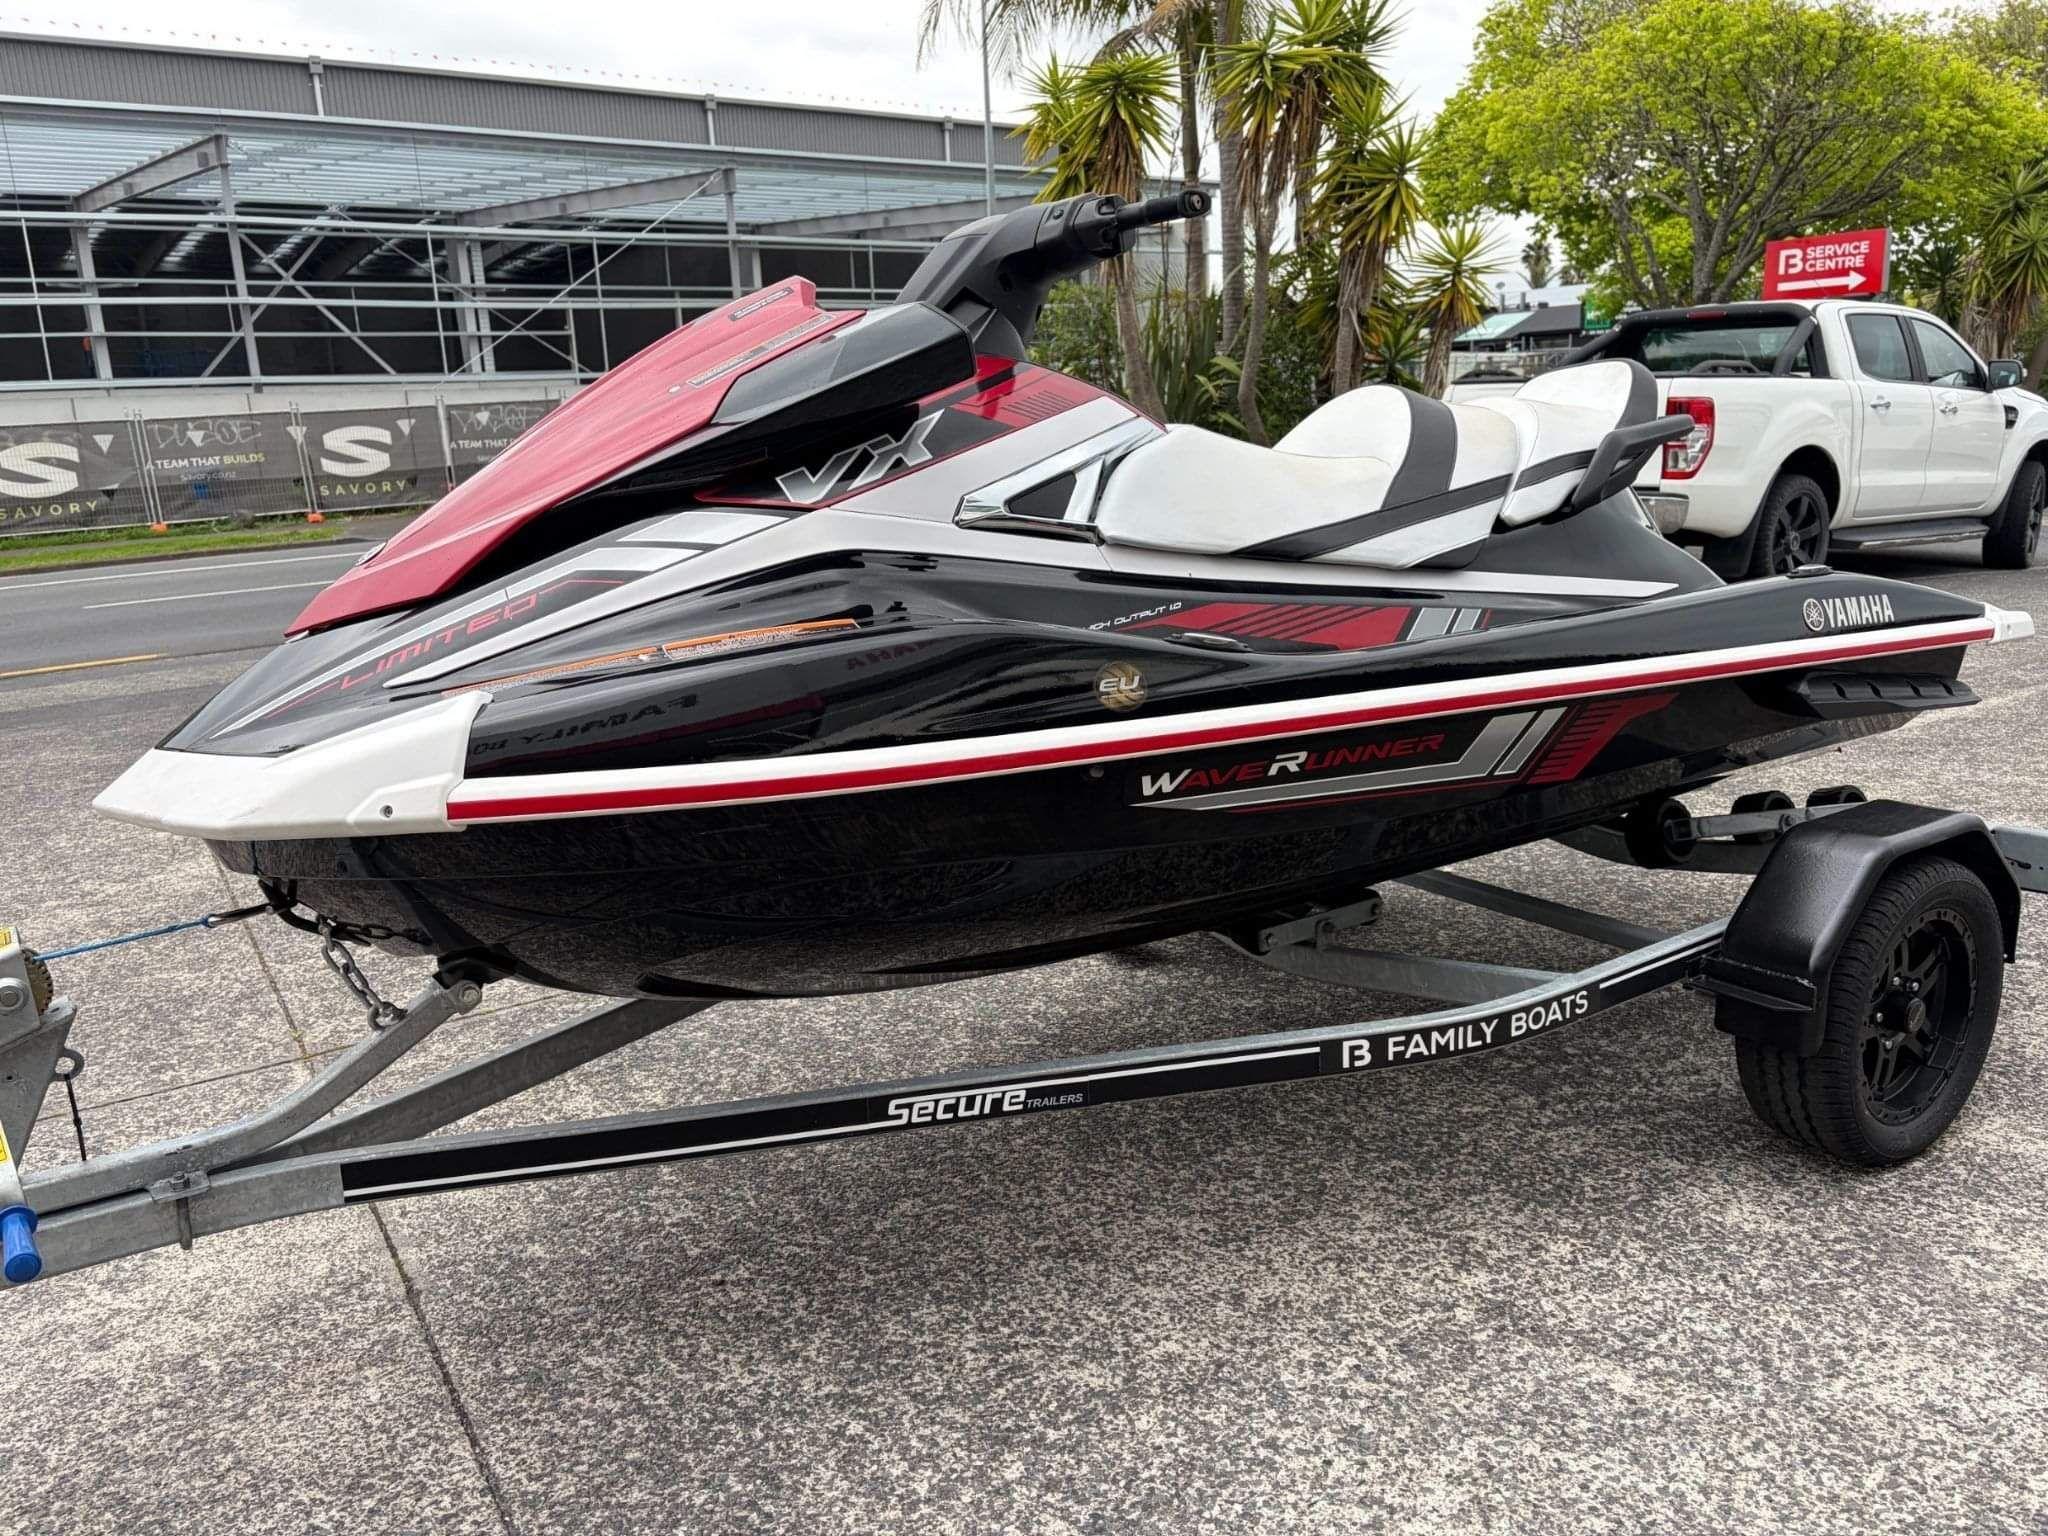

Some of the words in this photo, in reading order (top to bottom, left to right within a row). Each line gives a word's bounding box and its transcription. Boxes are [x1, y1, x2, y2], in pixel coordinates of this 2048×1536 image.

[1806, 240, 1870, 259] SERVICE
[1805, 255, 1866, 272] CENTRE
[458, 439, 482, 449] TEAM
[156, 457, 189, 470] TEAM
[189, 455, 221, 467] THAT
[222, 452, 266, 465] BUILDS
[775, 408, 944, 504] VX
[320, 479, 406, 496] SAVORY
[0, 500, 97, 519] SAVORY
[1113, 605, 1167, 625] OUTPUT
[1822, 594, 1895, 628] YAMAHA
[339, 592, 537, 690] LIMITED
[1099, 675, 1140, 692] EU
[1388, 1018, 1499, 1062] FAMILY
[1510, 990, 1589, 1037] BOATS
[1026, 1093, 1084, 1109] TRAILERS
